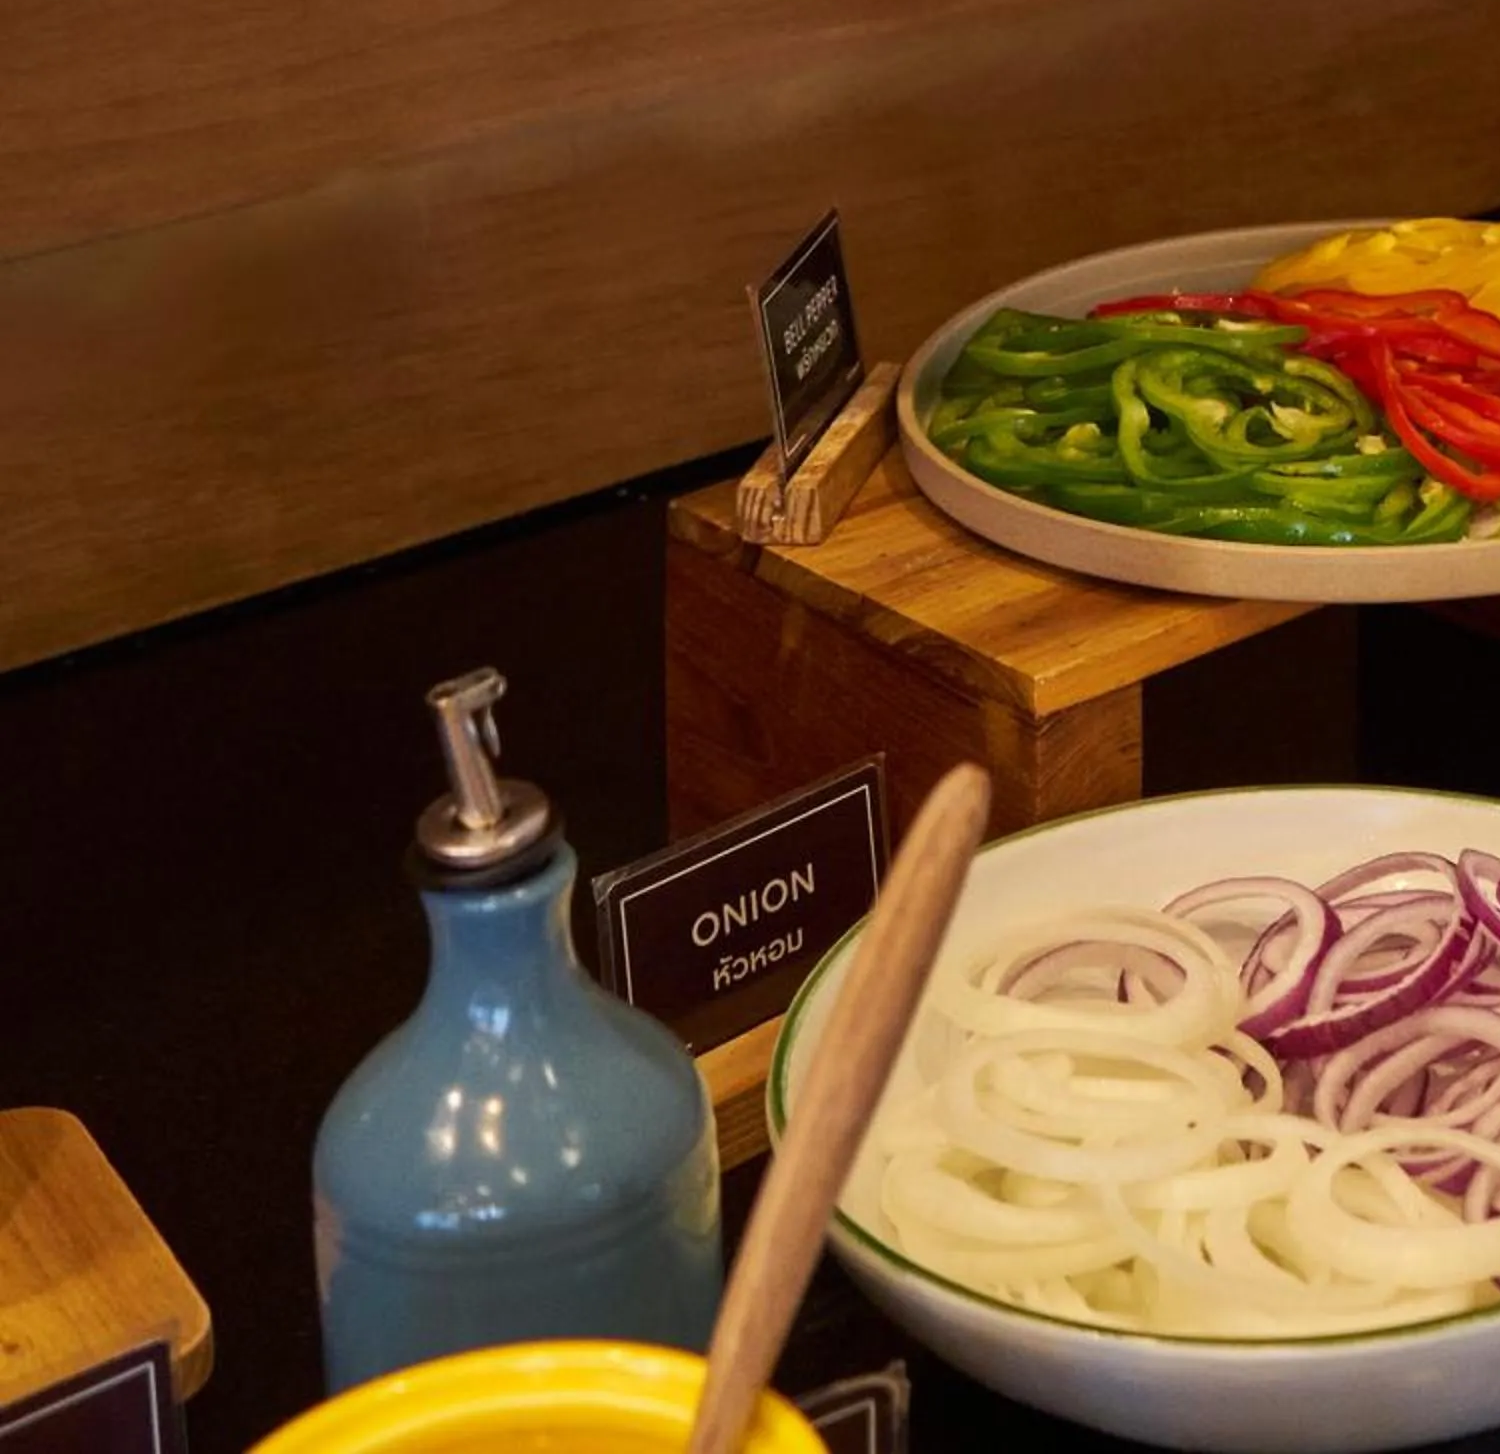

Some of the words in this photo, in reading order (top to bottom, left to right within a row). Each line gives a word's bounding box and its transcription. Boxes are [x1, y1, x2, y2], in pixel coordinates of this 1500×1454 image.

[691, 862, 815, 946] ONION
[713, 927, 803, 991] หัวหอม
